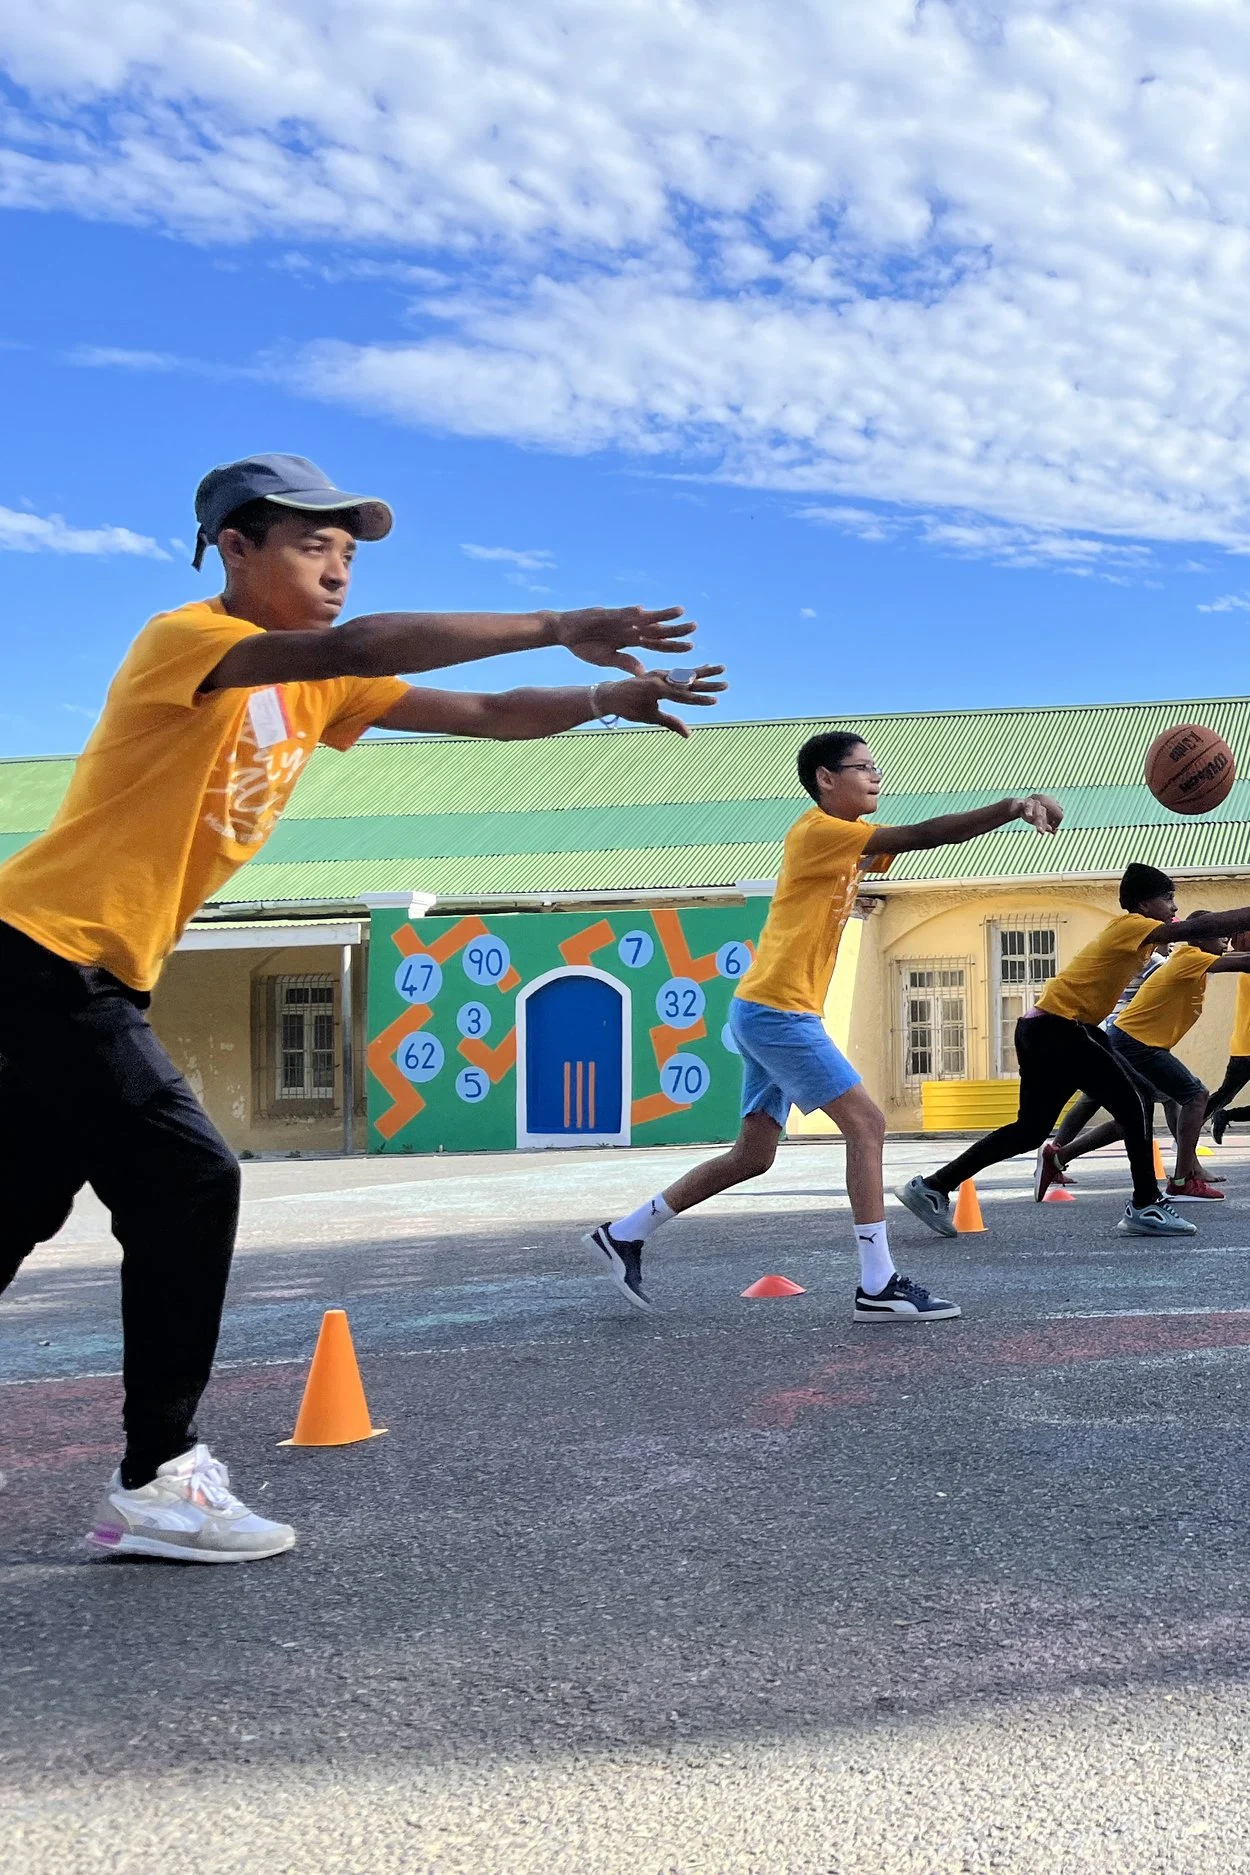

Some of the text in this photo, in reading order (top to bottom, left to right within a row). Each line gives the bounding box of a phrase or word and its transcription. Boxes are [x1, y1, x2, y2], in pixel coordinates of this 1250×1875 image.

[469, 948, 503, 977] 90
[625, 938, 643, 965] 7
[725, 946, 741, 975] 6
[401, 964, 434, 997] 47
[665, 989, 697, 1018] 32
[467, 1007, 481, 1035] 3
[404, 1042, 435, 1070] 62
[464, 1073, 482, 1099] 5
[668, 1065, 702, 1094] 70
